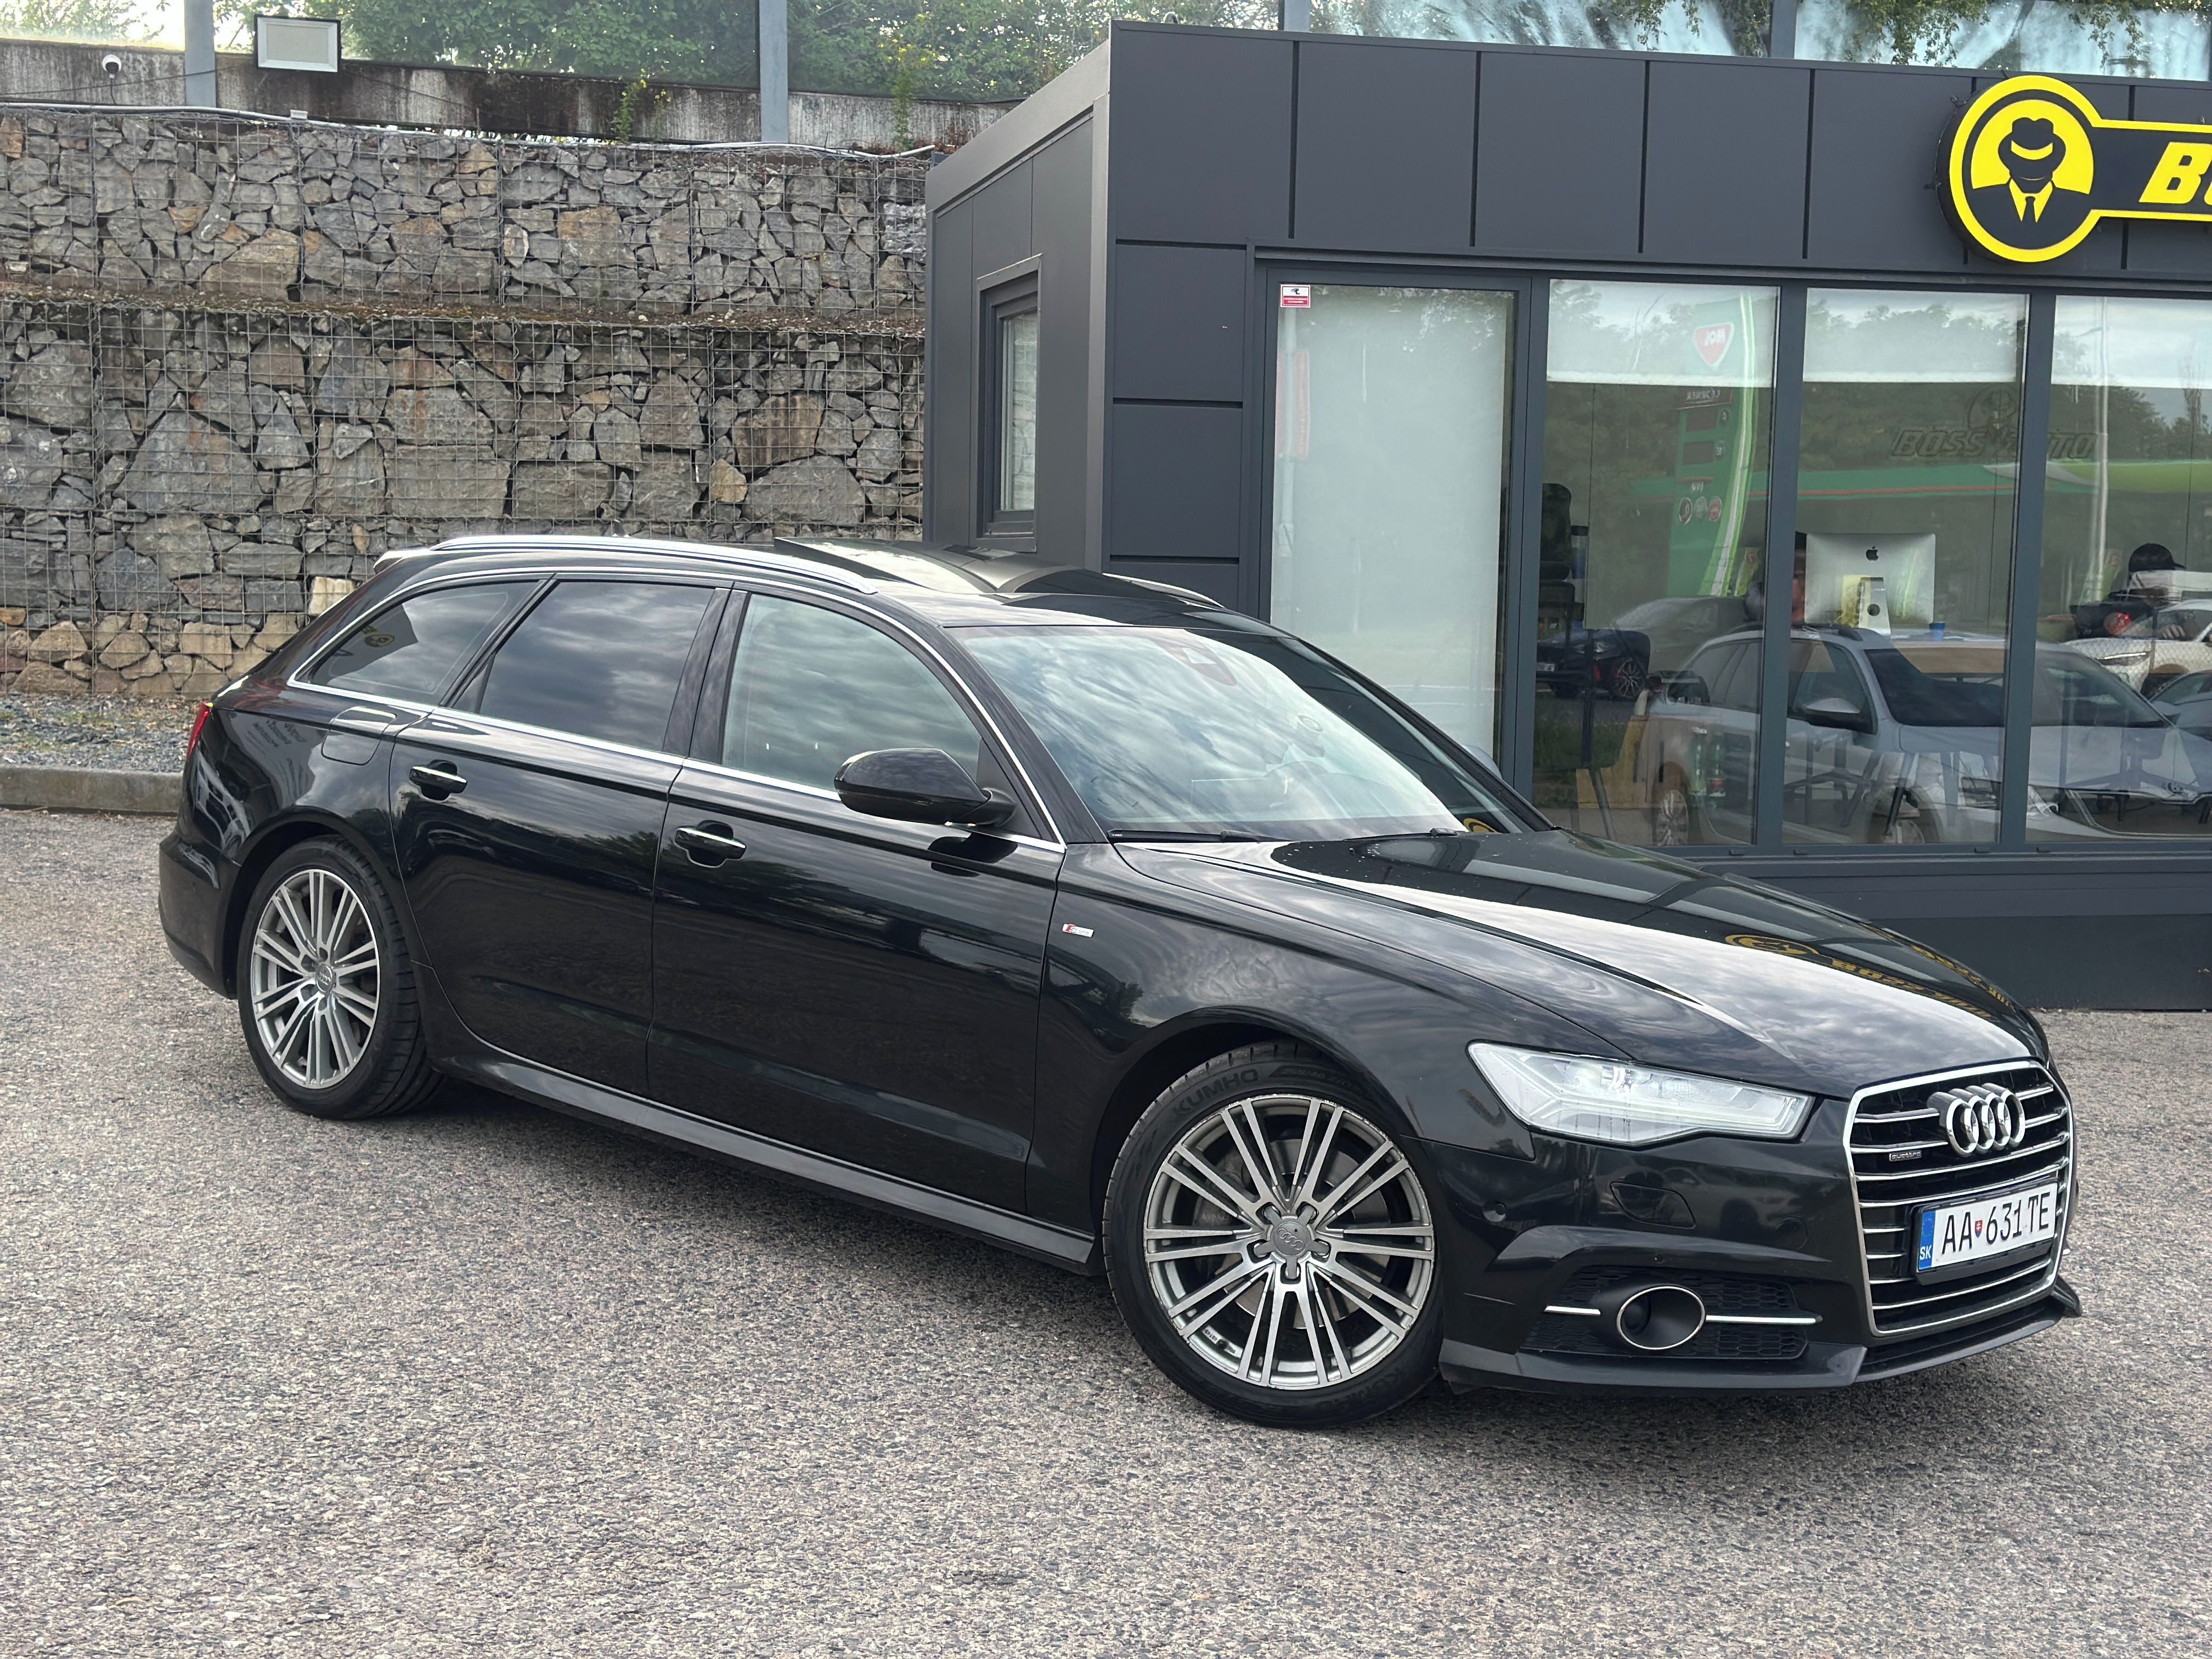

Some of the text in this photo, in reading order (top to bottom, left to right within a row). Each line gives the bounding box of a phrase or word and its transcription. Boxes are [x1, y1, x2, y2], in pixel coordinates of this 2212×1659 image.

[2139, 142, 2212, 206] B
[1892, 430, 1986, 456] BOSS
[1173, 1069, 1258, 1116] KUMHO
[1920, 1246, 1931, 1259] SK
[1942, 1211, 1972, 1255] AA
